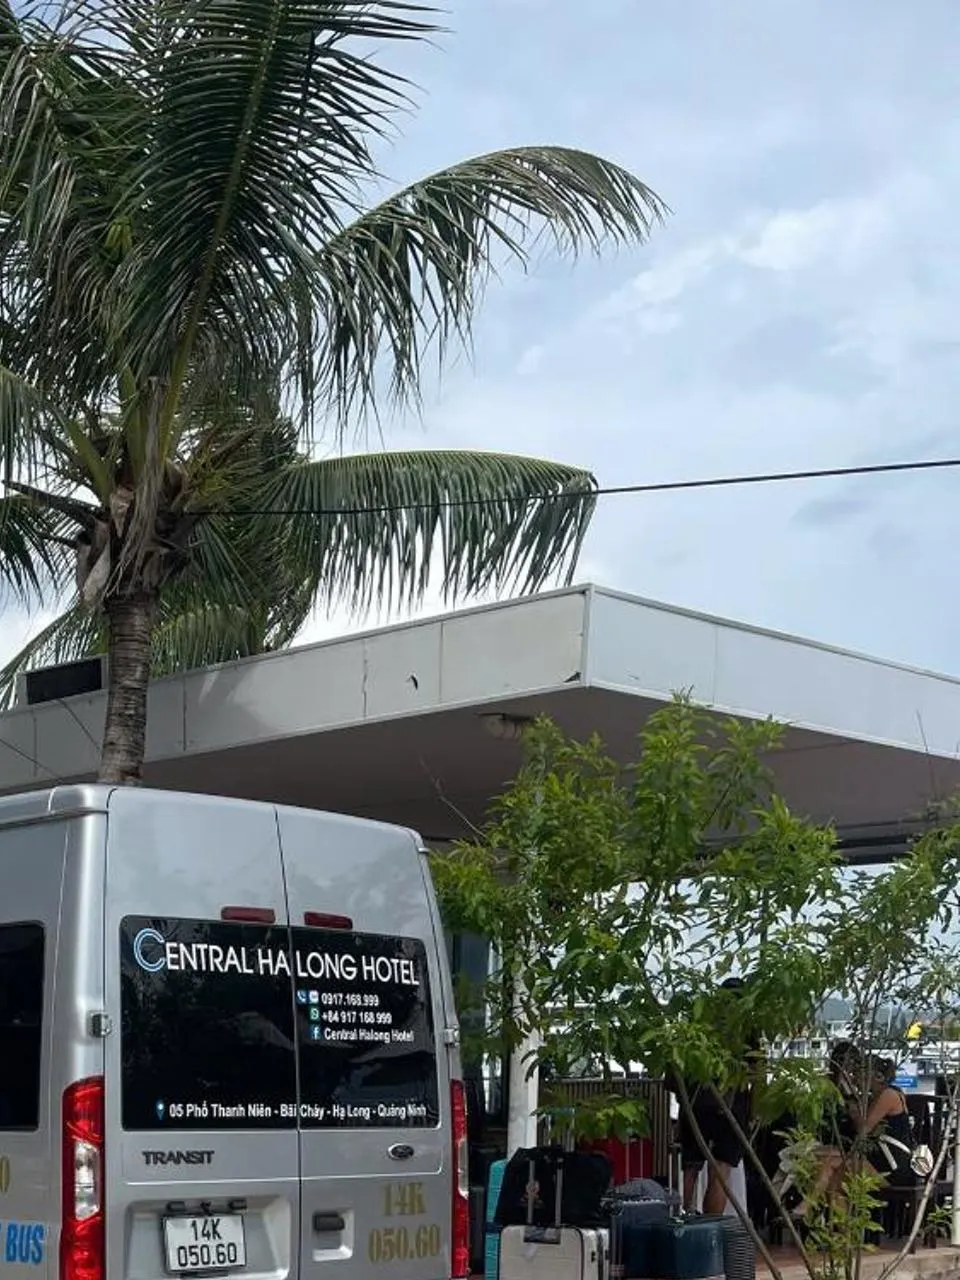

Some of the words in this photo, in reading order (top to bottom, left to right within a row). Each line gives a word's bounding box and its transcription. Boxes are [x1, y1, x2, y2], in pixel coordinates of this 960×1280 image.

[134, 928, 254, 974] CENTRAL
[258, 948, 291, 977] HA
[296, 951, 356, 980] LONG
[363, 956, 420, 986] HOTEL
[340, 1011, 357, 1023] 917
[324, 1027, 357, 1040] Central
[359, 1028, 390, 1044] Halong
[391, 1029, 415, 1042] Hotel
[169, 1103, 184, 1117] 05
[210, 1103, 245, 1117] Thanh
[347, 1104, 370, 1120] Long
[142, 1150, 215, 1165] TRANSIT
[190, 1218, 222, 1241] 14K
[5, 1222, 45, 1265] BUS
[177, 1242, 237, 1268] 050.60
